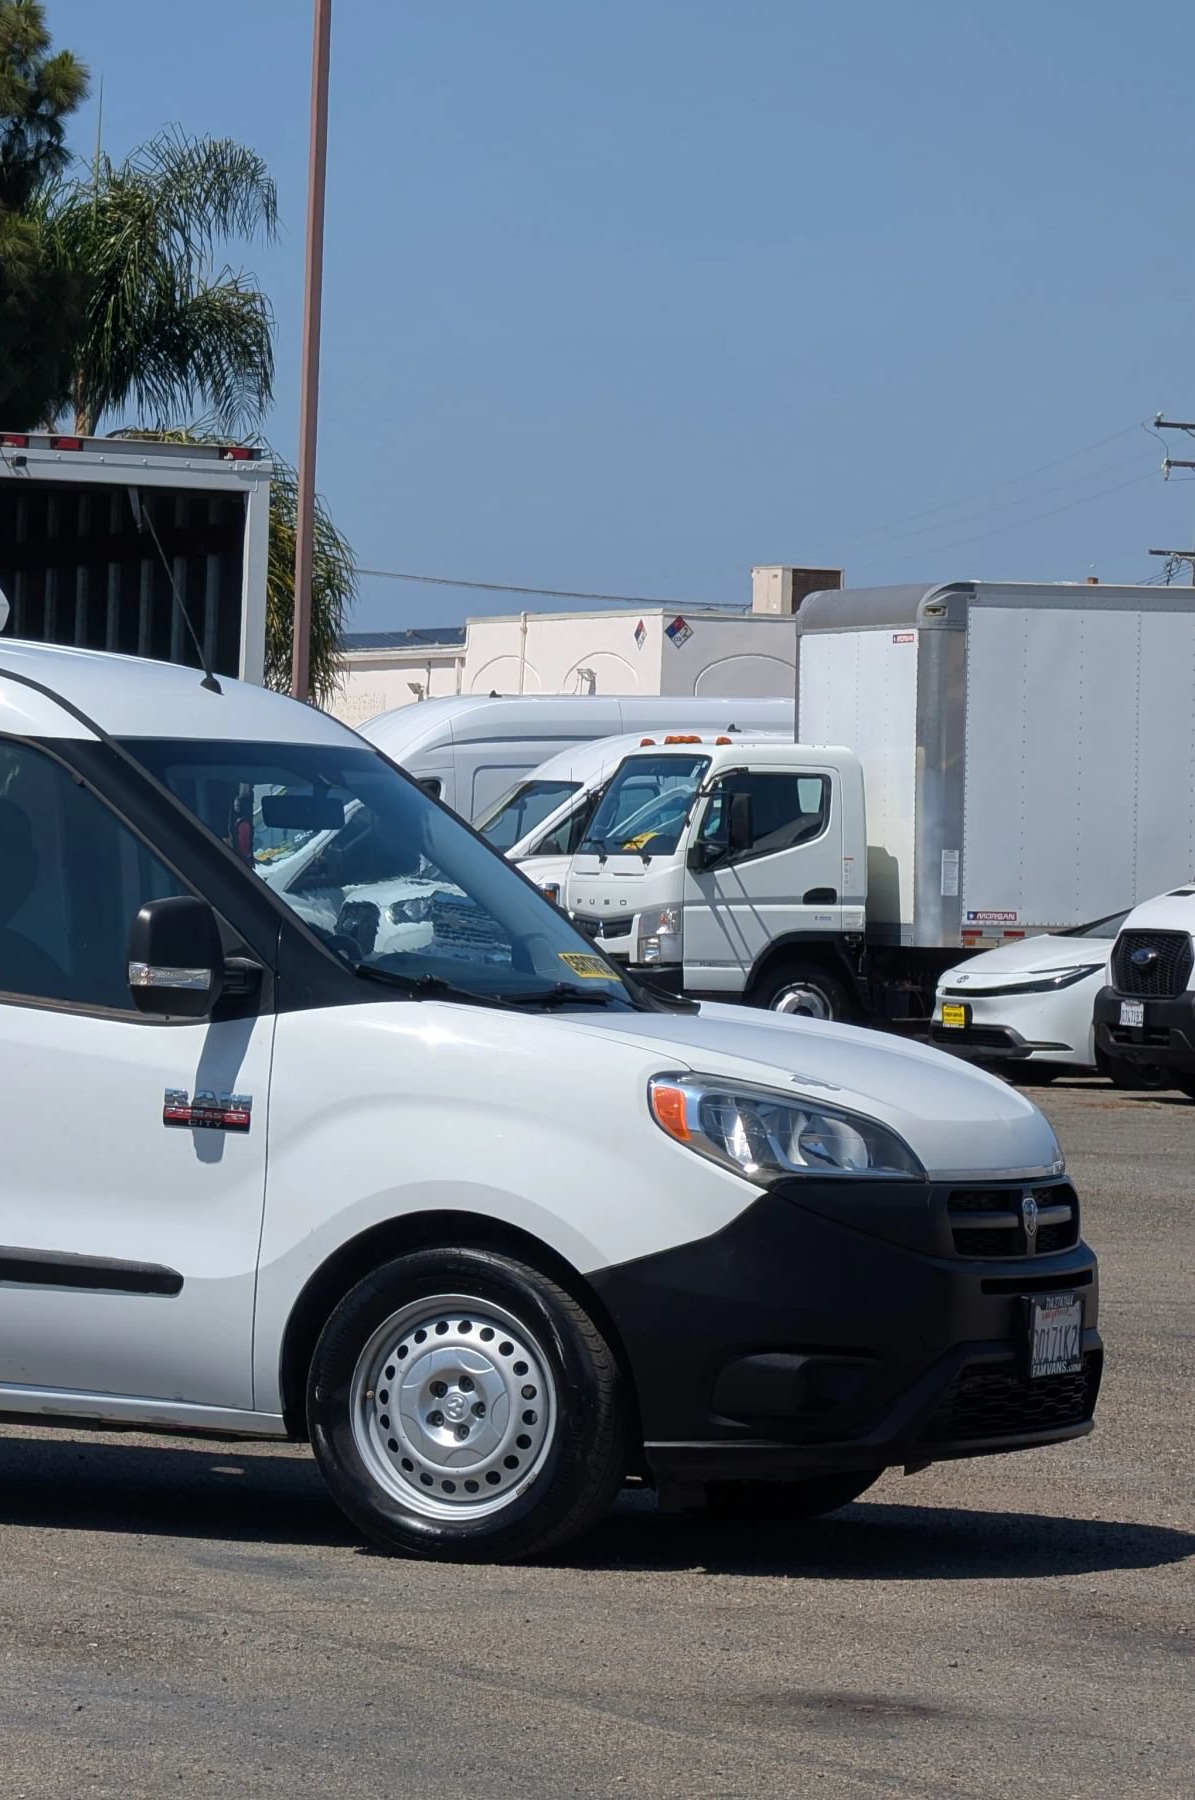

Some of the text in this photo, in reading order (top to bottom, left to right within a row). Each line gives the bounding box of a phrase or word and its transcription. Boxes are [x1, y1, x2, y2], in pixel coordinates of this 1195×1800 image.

[682, 627, 689, 639] 2
[976, 912, 1016, 920] MORGAN
[164, 1088, 253, 1112] RAM
[188, 1119, 222, 1127] CITY
